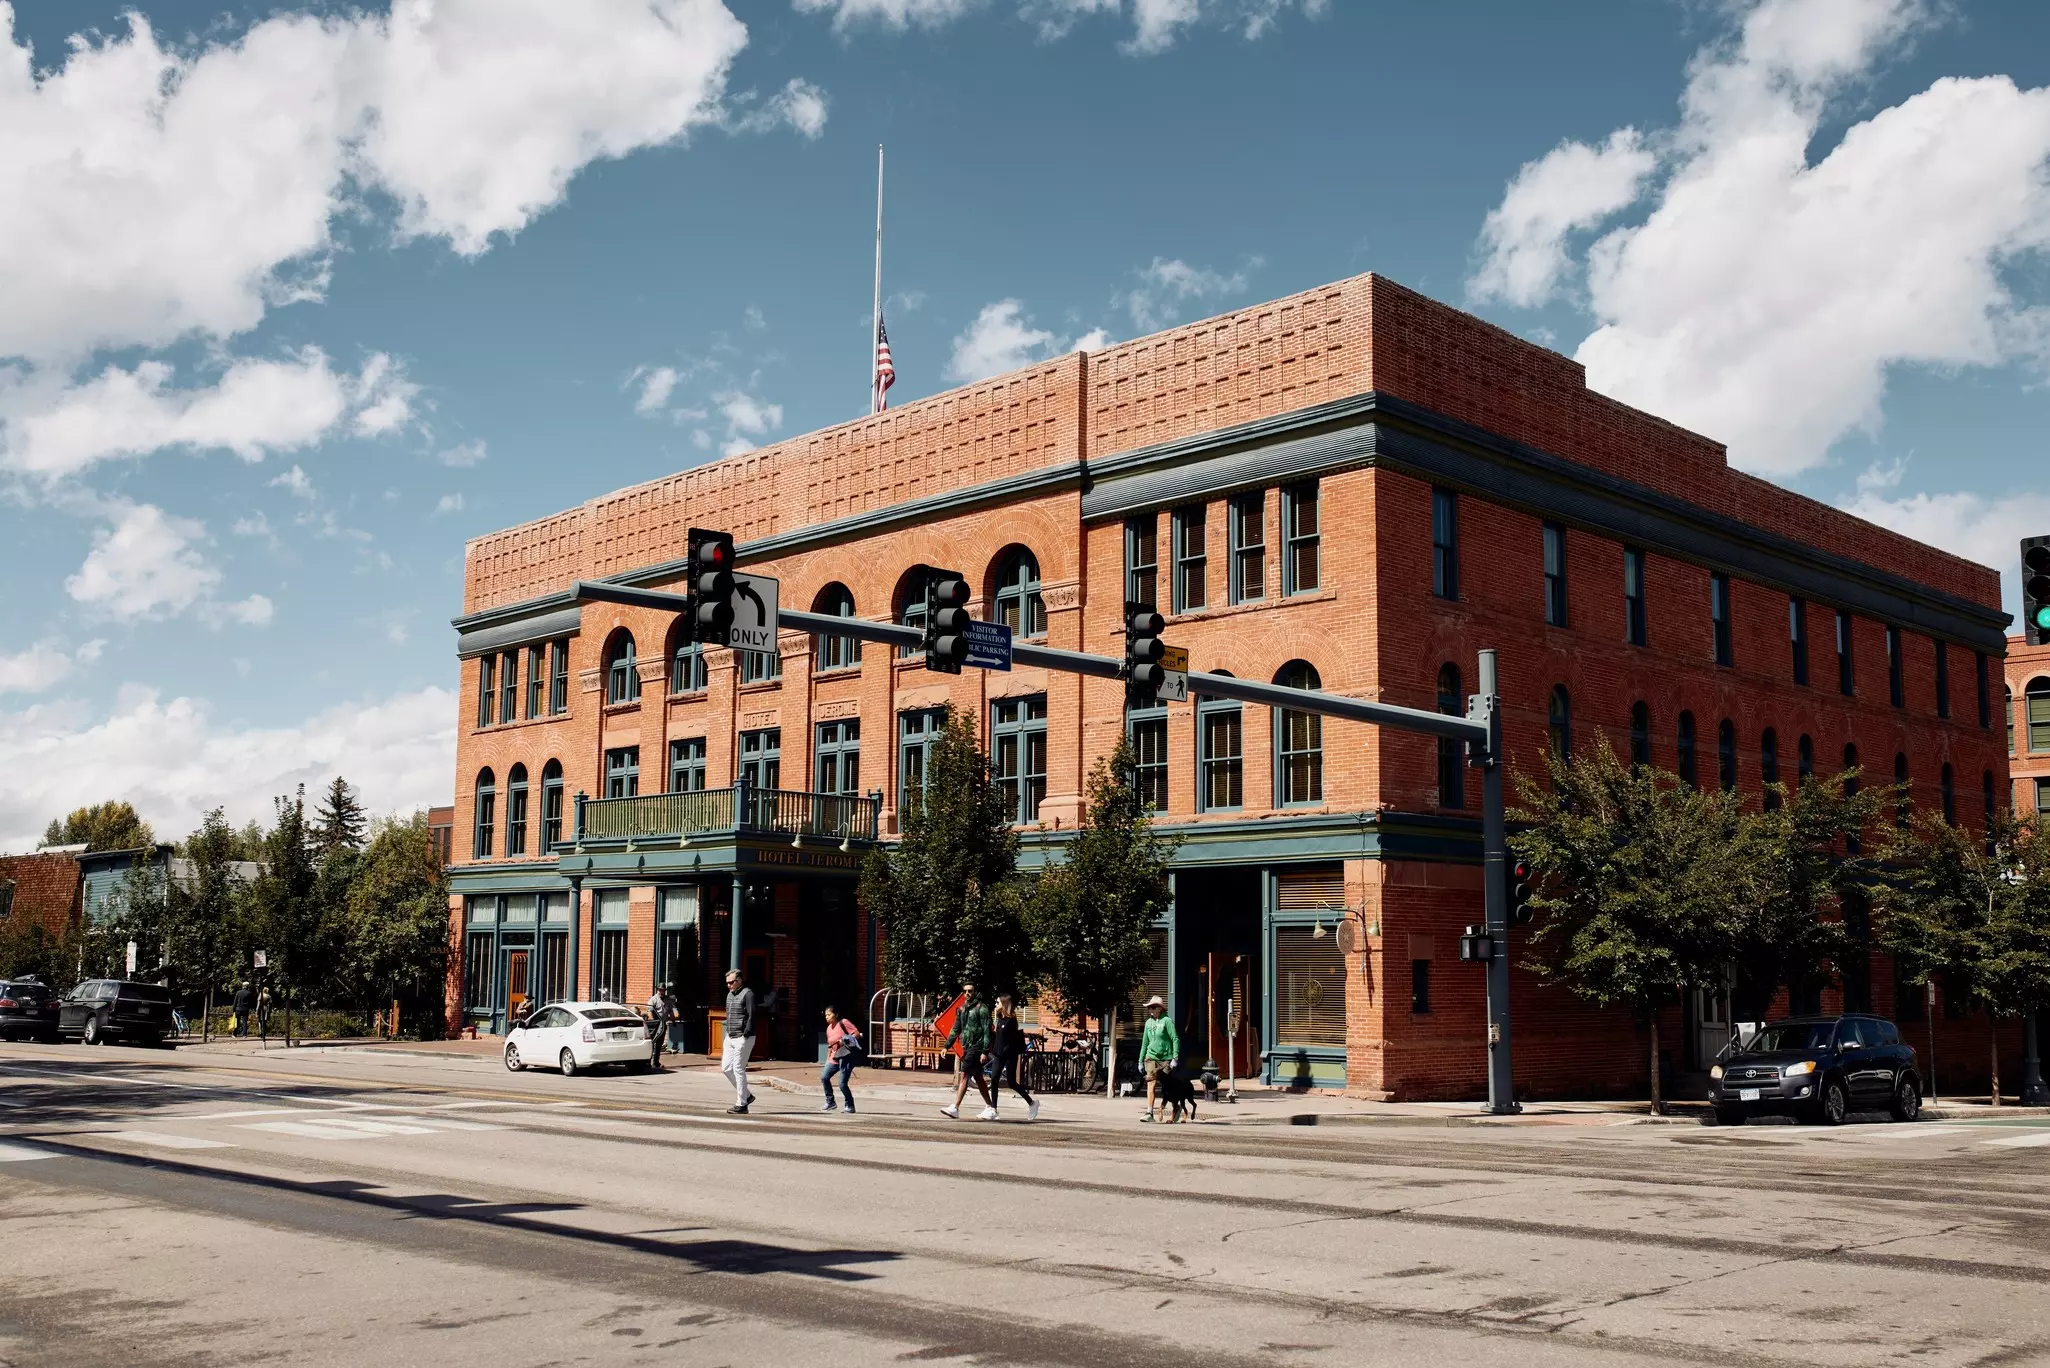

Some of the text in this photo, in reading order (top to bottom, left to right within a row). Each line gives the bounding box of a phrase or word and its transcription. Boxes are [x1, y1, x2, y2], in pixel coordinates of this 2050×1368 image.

[972, 625, 997, 634] VISITOR
[731, 628, 769, 646] ONLY
[962, 631, 1006, 643] INFORMATION
[983, 646, 1009, 656] PARKING
[744, 702, 858, 728] HOTEL JEROME
[758, 851, 803, 864] HOTEL
